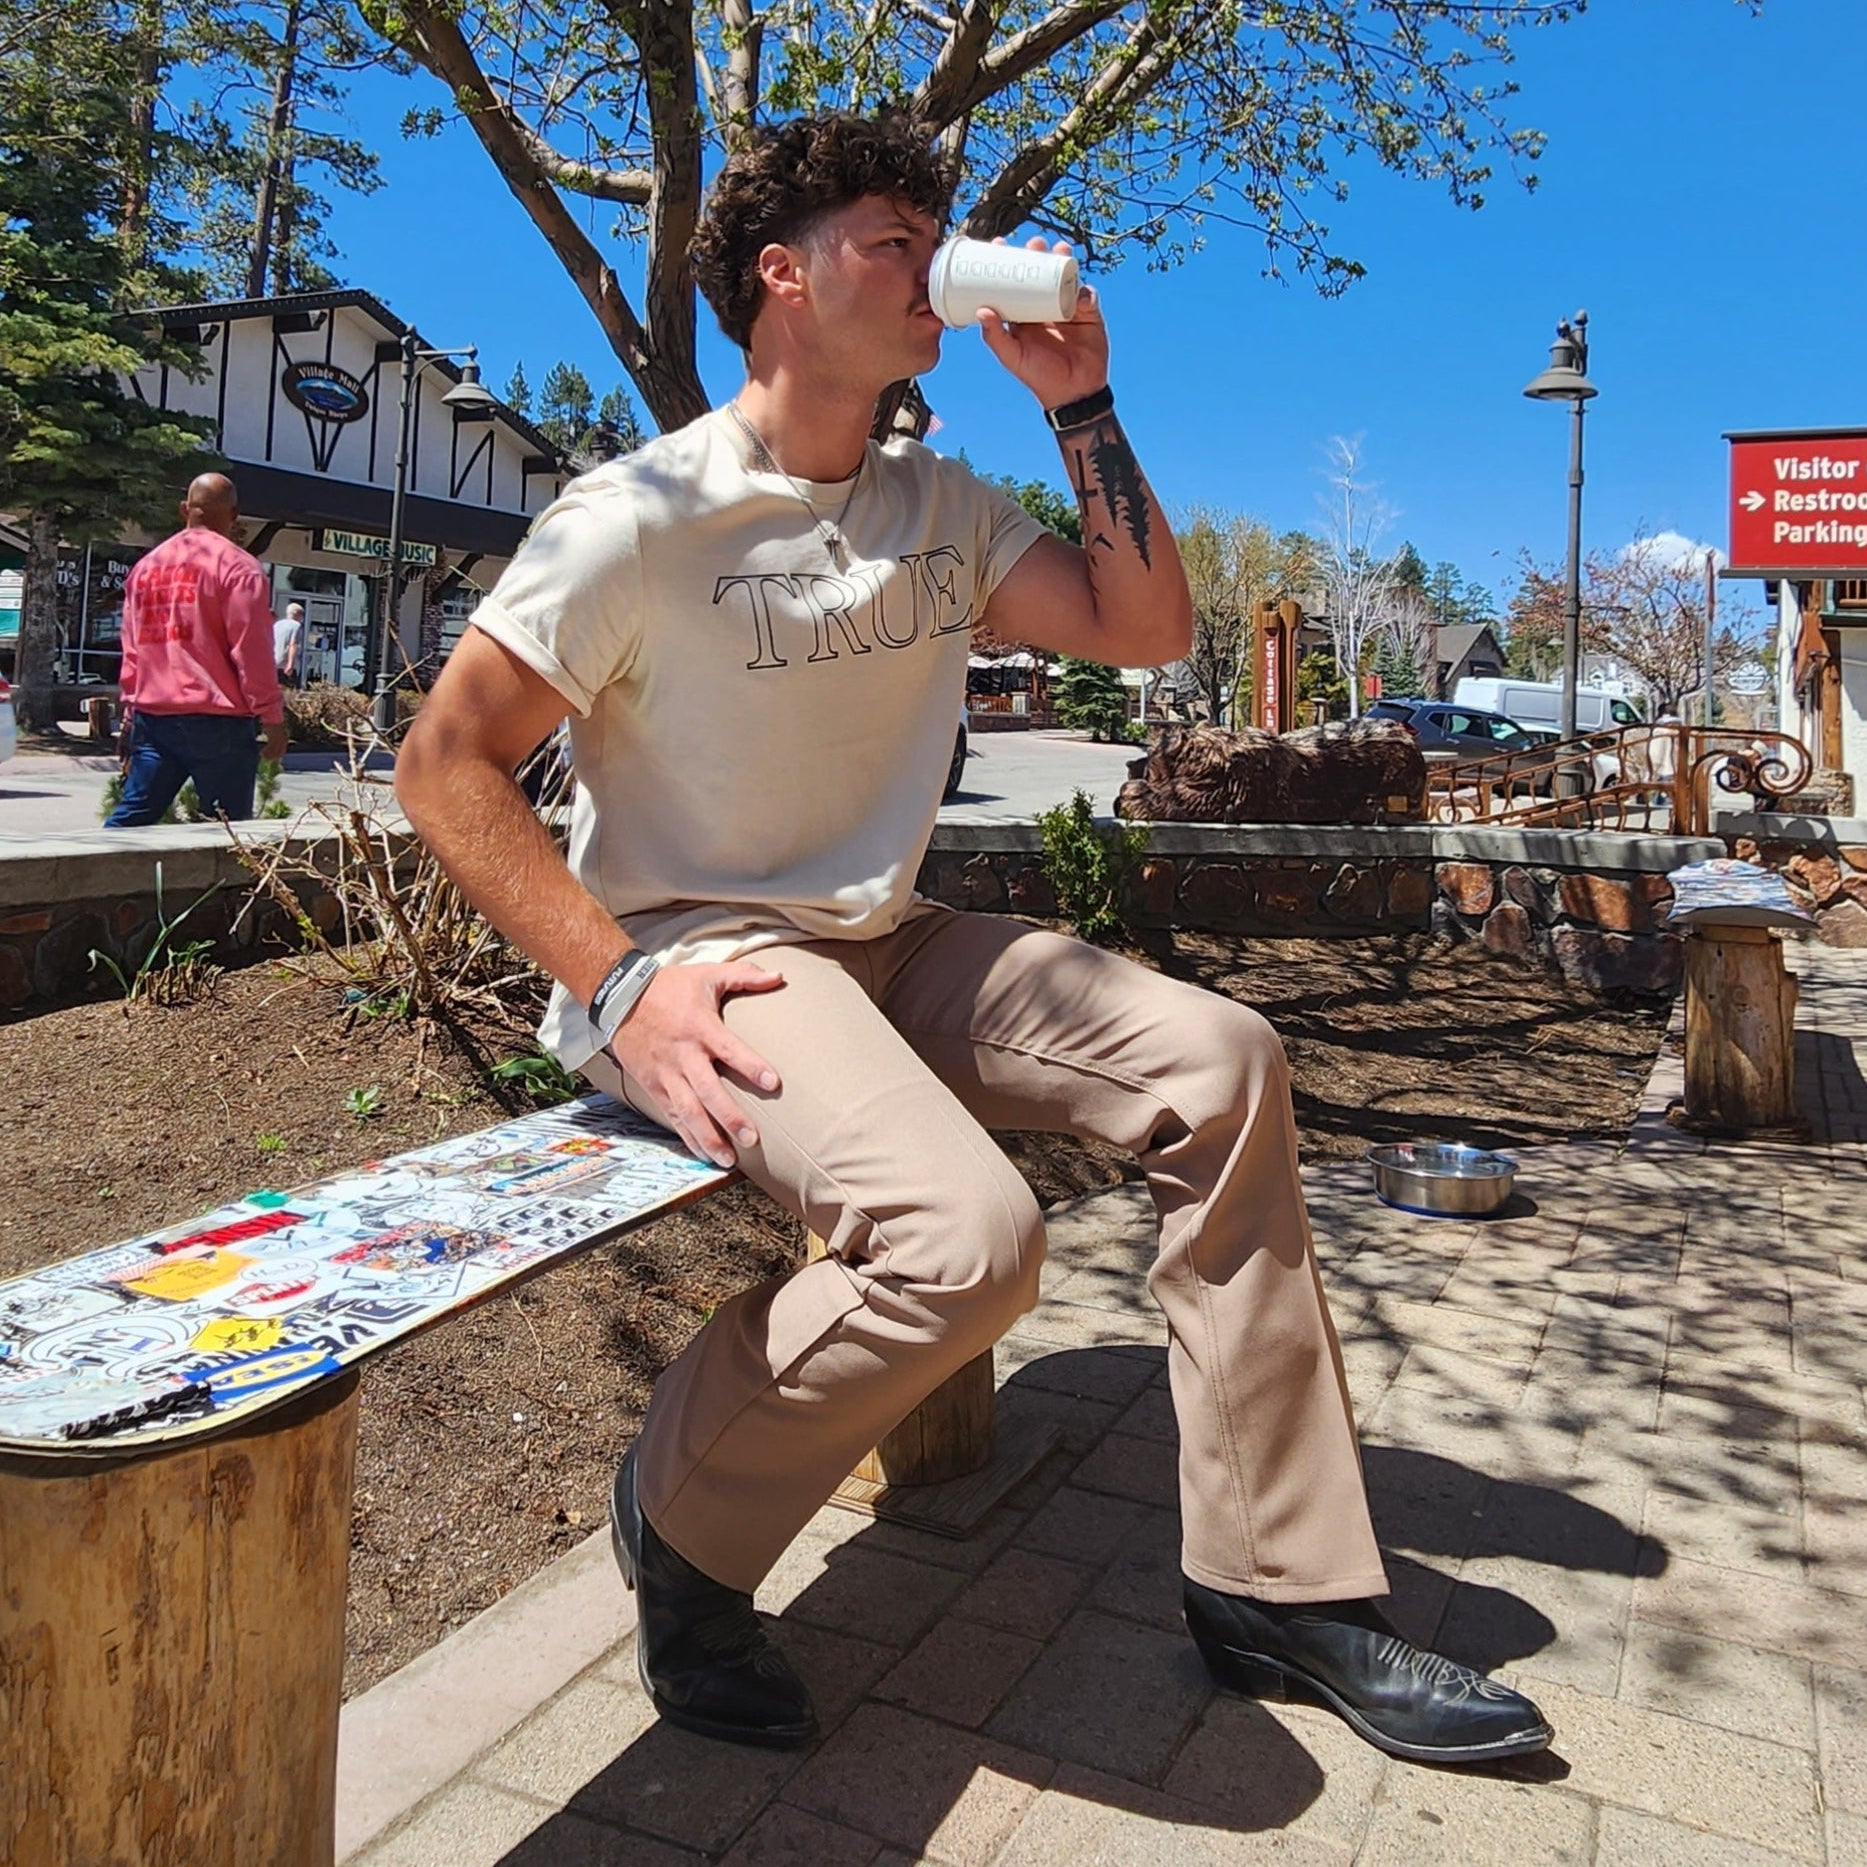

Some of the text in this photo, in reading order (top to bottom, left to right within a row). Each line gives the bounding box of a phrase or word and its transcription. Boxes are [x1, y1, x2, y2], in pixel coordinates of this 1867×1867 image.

[298, 364, 360, 394] Village Mall
[1773, 456, 1860, 480] Visitor
[333, 531, 434, 564] VILLAGE USIC
[1773, 519, 1867, 548] Parking
[712, 545, 974, 670] TRUE
